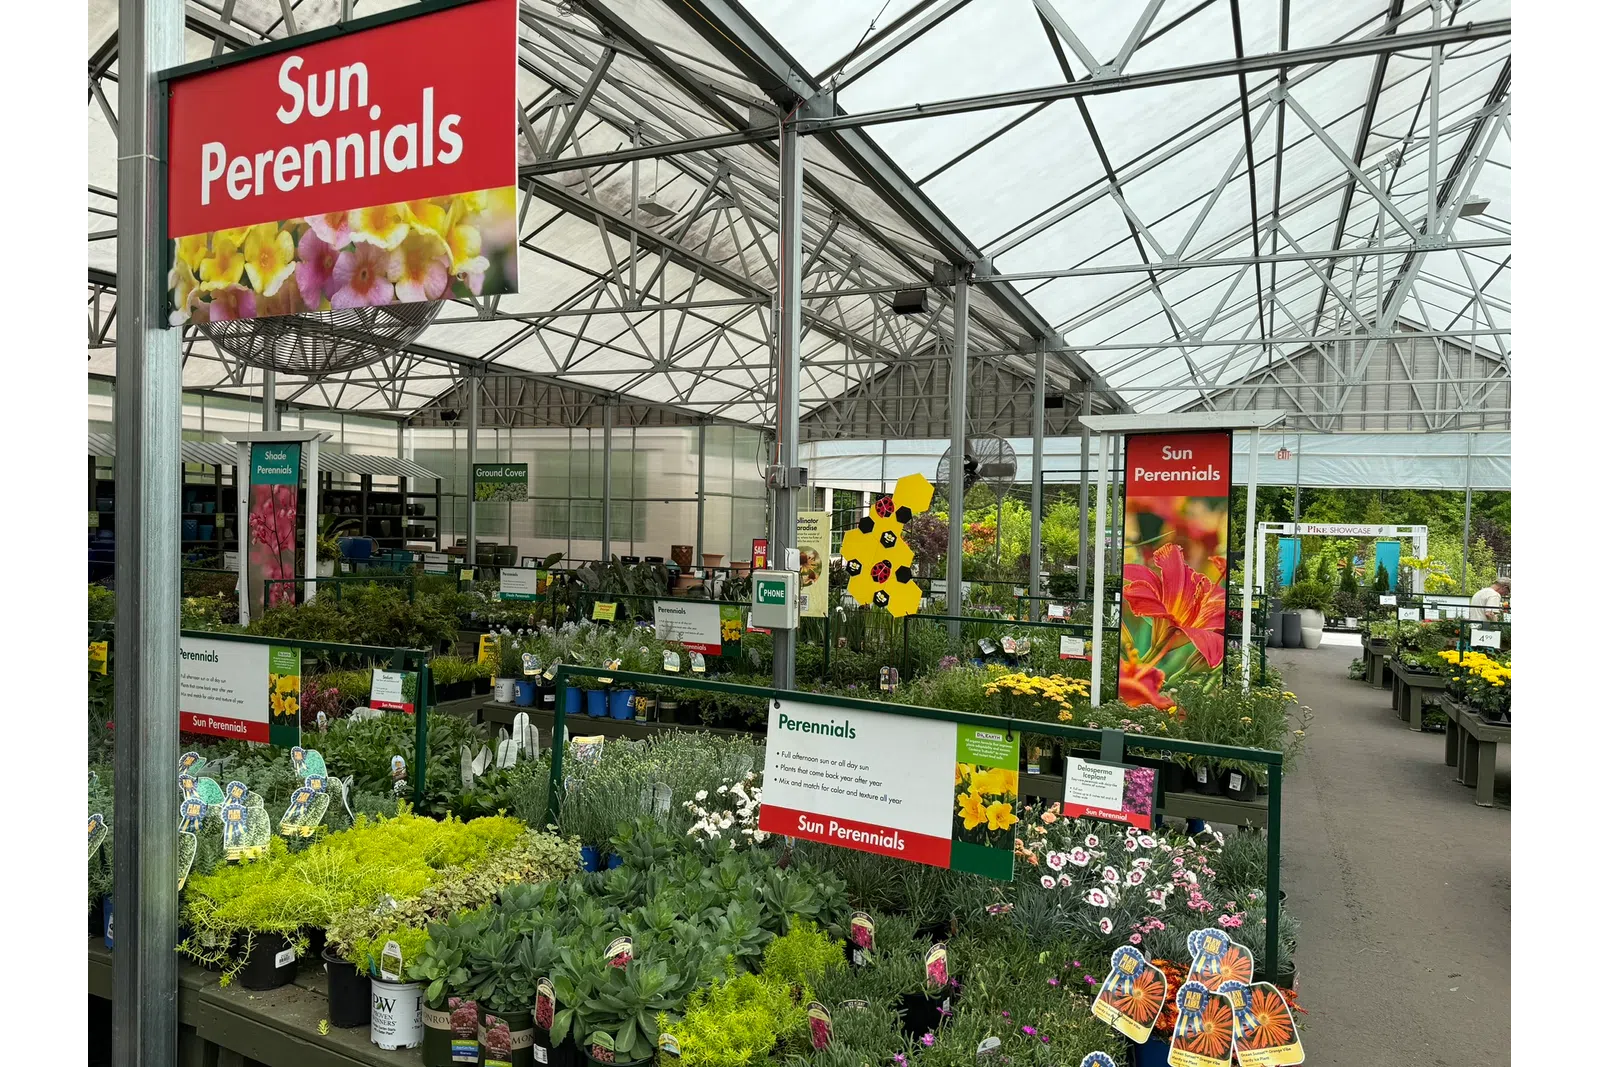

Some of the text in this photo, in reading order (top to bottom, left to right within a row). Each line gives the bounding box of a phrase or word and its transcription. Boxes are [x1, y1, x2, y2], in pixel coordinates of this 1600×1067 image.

[276, 56, 368, 124] Sun
[201, 87, 463, 206] Perennials
[265, 451, 286, 460] Shade
[1162, 446, 1192, 460] Sun
[1278, 451, 1290, 460] EXIT
[257, 465, 292, 474] Perennials
[476, 468, 526, 477] Ground Cover
[1135, 465, 1220, 481] Perennials
[754, 546, 766, 554] SALE
[193, 715, 247, 733] Sun Perennials
[779, 714, 856, 739] Perennials
[792, 752, 818, 763] afternoon
[847, 761, 858, 770] day
[780, 764, 796, 773] Plants
[826, 771, 839, 780] back
[855, 776, 868, 784] after
[1078, 764, 1112, 775] Delosperma
[1083, 772, 1106, 780] Iceplant
[803, 782, 820, 790] match
[821, 784, 829, 792] for
[831, 786, 845, 794] color
[859, 791, 878, 801] texture
[1086, 808, 1127, 820] Sun Perennial
[798, 815, 904, 850] Sun Perennials
[423, 1011, 450, 1025] ONROV
